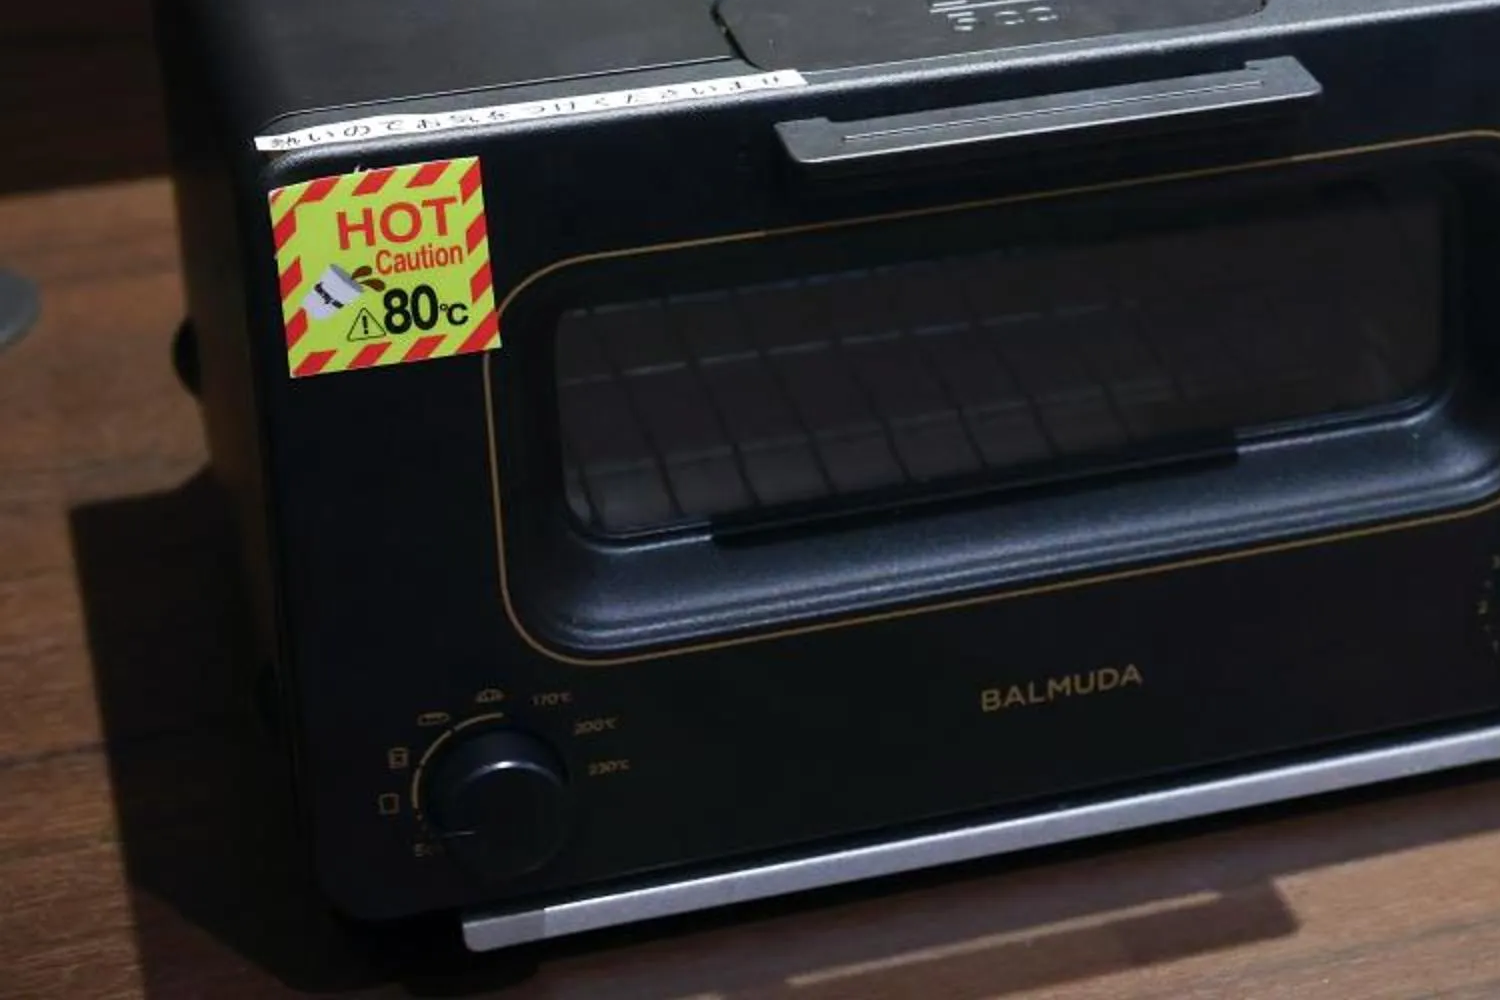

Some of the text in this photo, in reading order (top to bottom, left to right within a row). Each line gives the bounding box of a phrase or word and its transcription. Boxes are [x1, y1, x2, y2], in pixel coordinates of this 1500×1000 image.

[336, 196, 458, 250] HOT
[375, 243, 464, 276] Caution
[980, 663, 1143, 711] BALMUDA
